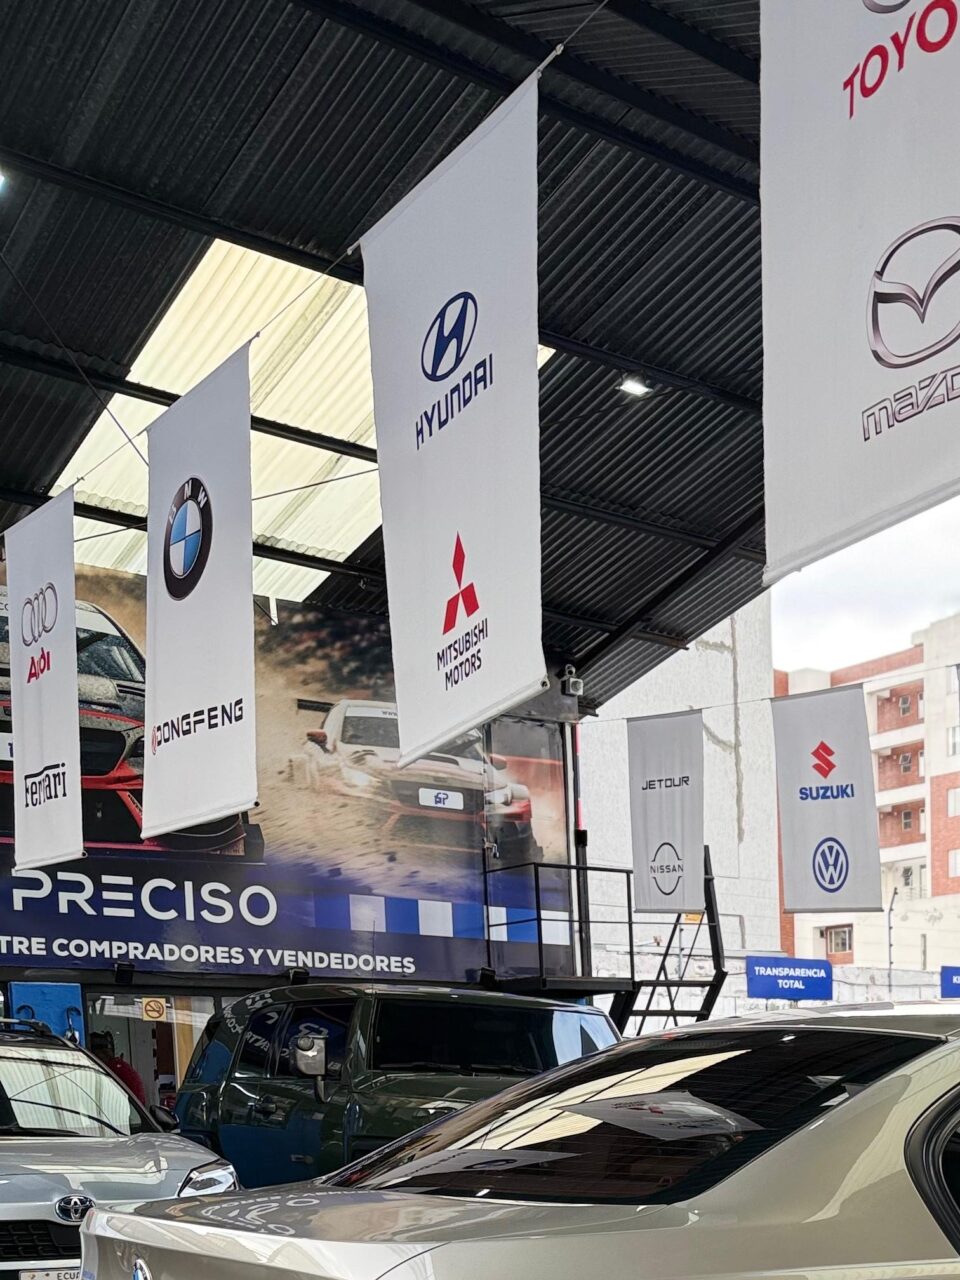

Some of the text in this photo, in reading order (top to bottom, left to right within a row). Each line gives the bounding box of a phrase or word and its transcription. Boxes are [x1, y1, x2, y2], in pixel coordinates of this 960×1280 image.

[416, 353, 493, 451] HYUNDAI
[437, 617, 488, 671] MITSUBISHI
[445, 648, 482, 692] MOTORS
[157, 698, 243, 748] DONGFENG
[641, 776, 690, 791] JETOUR
[799, 784, 854, 801] SUZUKI
[650, 864, 684, 874] NISSAN
[12, 868, 278, 927] PRECISO
[0, 935, 416, 974] TRE COMPRADORES Y VENDEDORES
[754, 966, 826, 978] TRANSPARENCIA
[777, 979, 805, 989] TOTAL
